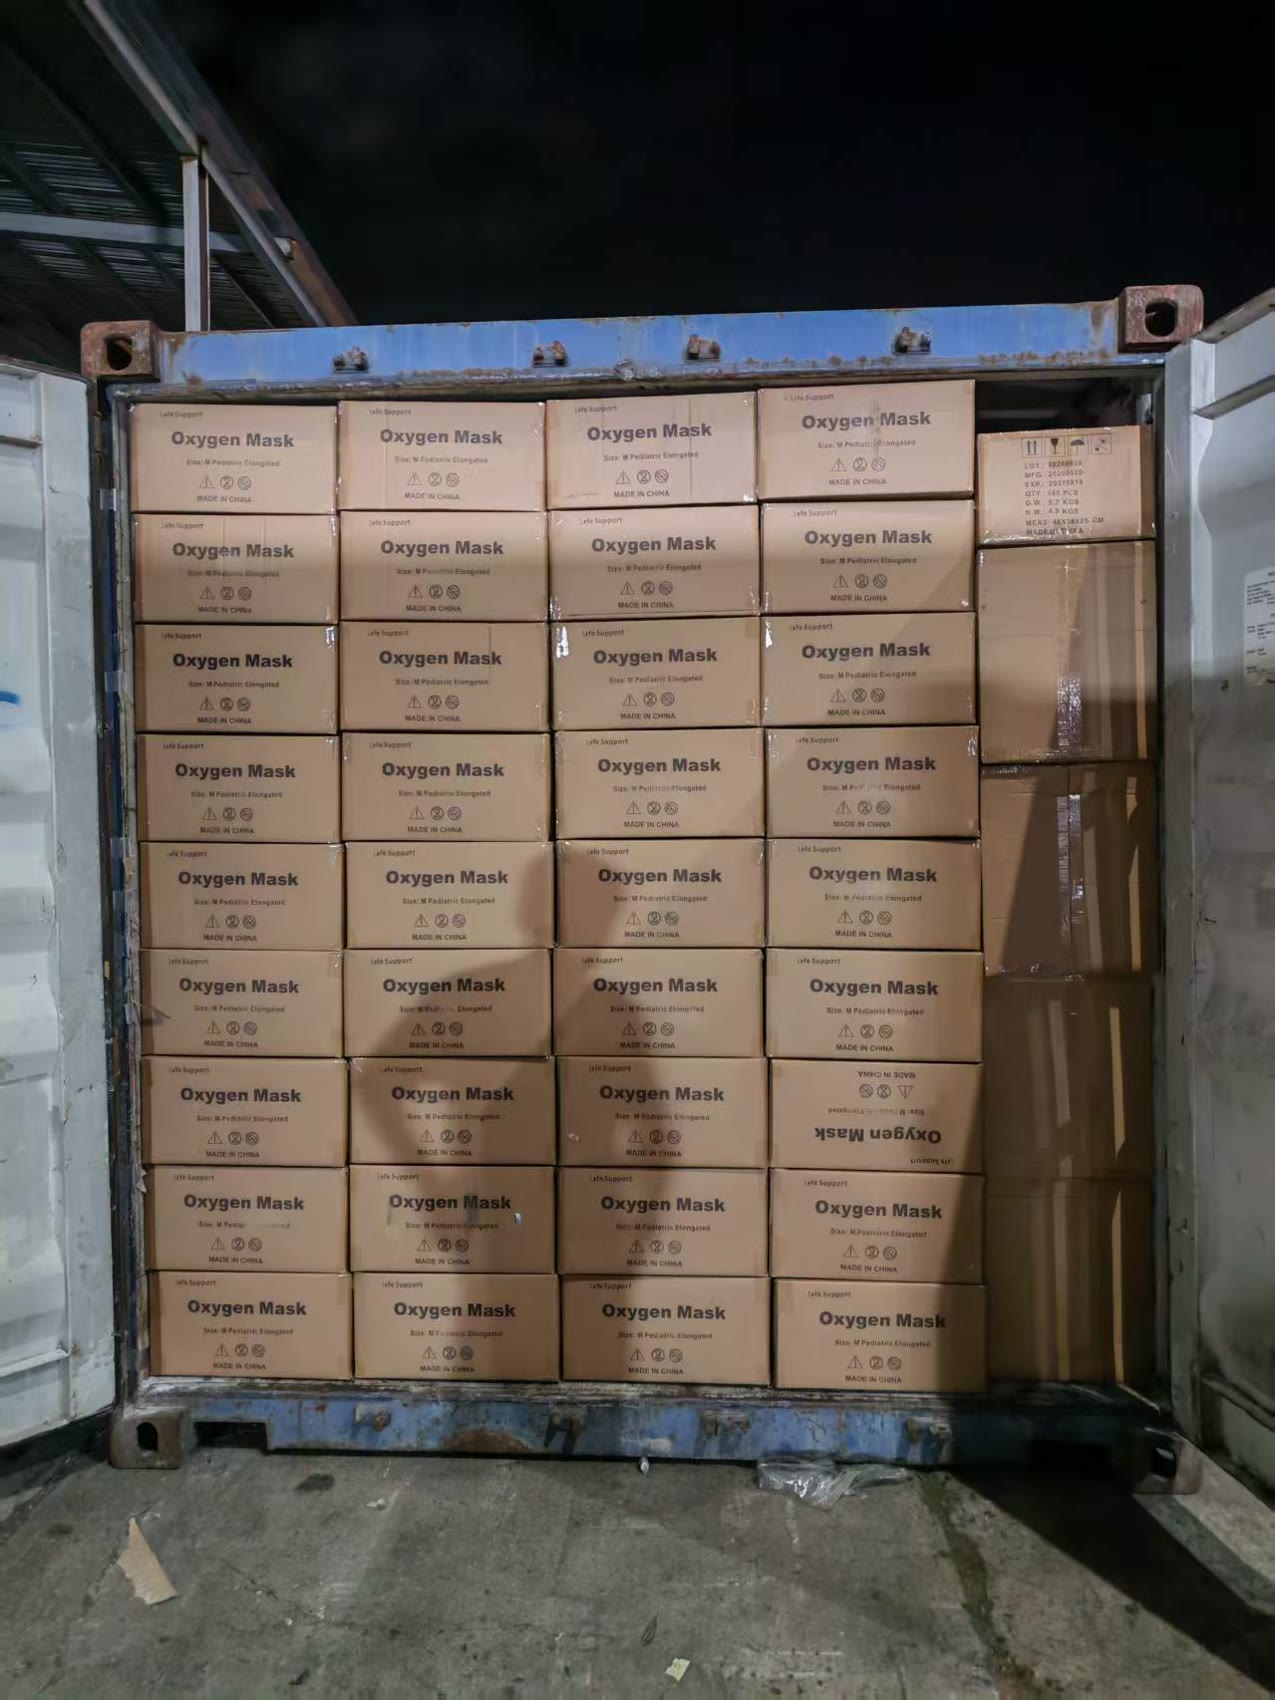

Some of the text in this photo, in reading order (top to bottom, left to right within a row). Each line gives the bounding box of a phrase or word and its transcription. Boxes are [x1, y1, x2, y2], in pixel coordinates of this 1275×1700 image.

[802, 411, 931, 431] Oxygen Mask
[172, 431, 294, 448] Oxygen Mask
[381, 429, 502, 446] Oxygen Mask
[587, 423, 712, 443] Oxygen Mask
[613, 490, 635, 498] MADE
[592, 536, 716, 555] Oxygen Mask
[805, 530, 932, 547] Oxygen Mask
[173, 543, 294, 560] Oxygen Mask
[381, 540, 503, 557] Oxygen Mask
[831, 594, 854, 602] MADE
[379, 651, 502, 668] Oxygen Mask
[594, 648, 717, 666] Oxygen Mask
[802, 642, 930, 661] Oxygen Mask
[173, 653, 293, 670] Oxygen Mask
[198, 716, 219, 725] MADE
[619, 712, 641, 720] MADE
[175, 763, 295, 780] Oxygen Mask
[382, 763, 504, 779] Oxygen Mask
[598, 758, 721, 775] Oxygen Mask
[807, 757, 936, 774] Oxygen Mask
[407, 826, 429, 834] MADE
[178, 871, 299, 888] Oxygen Mask
[386, 870, 508, 887] Oxygen Mask
[598, 869, 722, 885] Oxygen Mask
[809, 866, 937, 884] Oxygen Mask
[203, 934, 224, 942] MADE
[835, 930, 858, 938] MADE
[179, 978, 299, 995] Oxygen Mask
[383, 977, 506, 995] Oxygen Mask
[594, 978, 717, 995] Oxygen Mask
[810, 979, 938, 997] Oxygen Mask
[836, 1044, 859, 1052] MADE
[180, 1088, 301, 1105] Oxygen Mask
[392, 1086, 515, 1103] Oxygen Mask
[600, 1085, 724, 1104] Oxygen Mask
[814, 1126, 941, 1144] Oxygen Mask
[626, 1148, 648, 1157] MADE
[184, 1194, 304, 1212] Oxygen Mask
[389, 1195, 511, 1212] Oxygen Mask
[601, 1196, 725, 1214] Oxygen Mask
[815, 1200, 942, 1219] Oxygen Mask
[187, 1300, 306, 1317] Oxygen Mask
[394, 1302, 516, 1319] Oxygen Mask
[602, 1304, 726, 1321] Oxygen Mask
[819, 1311, 946, 1329] Oxygen Mask
